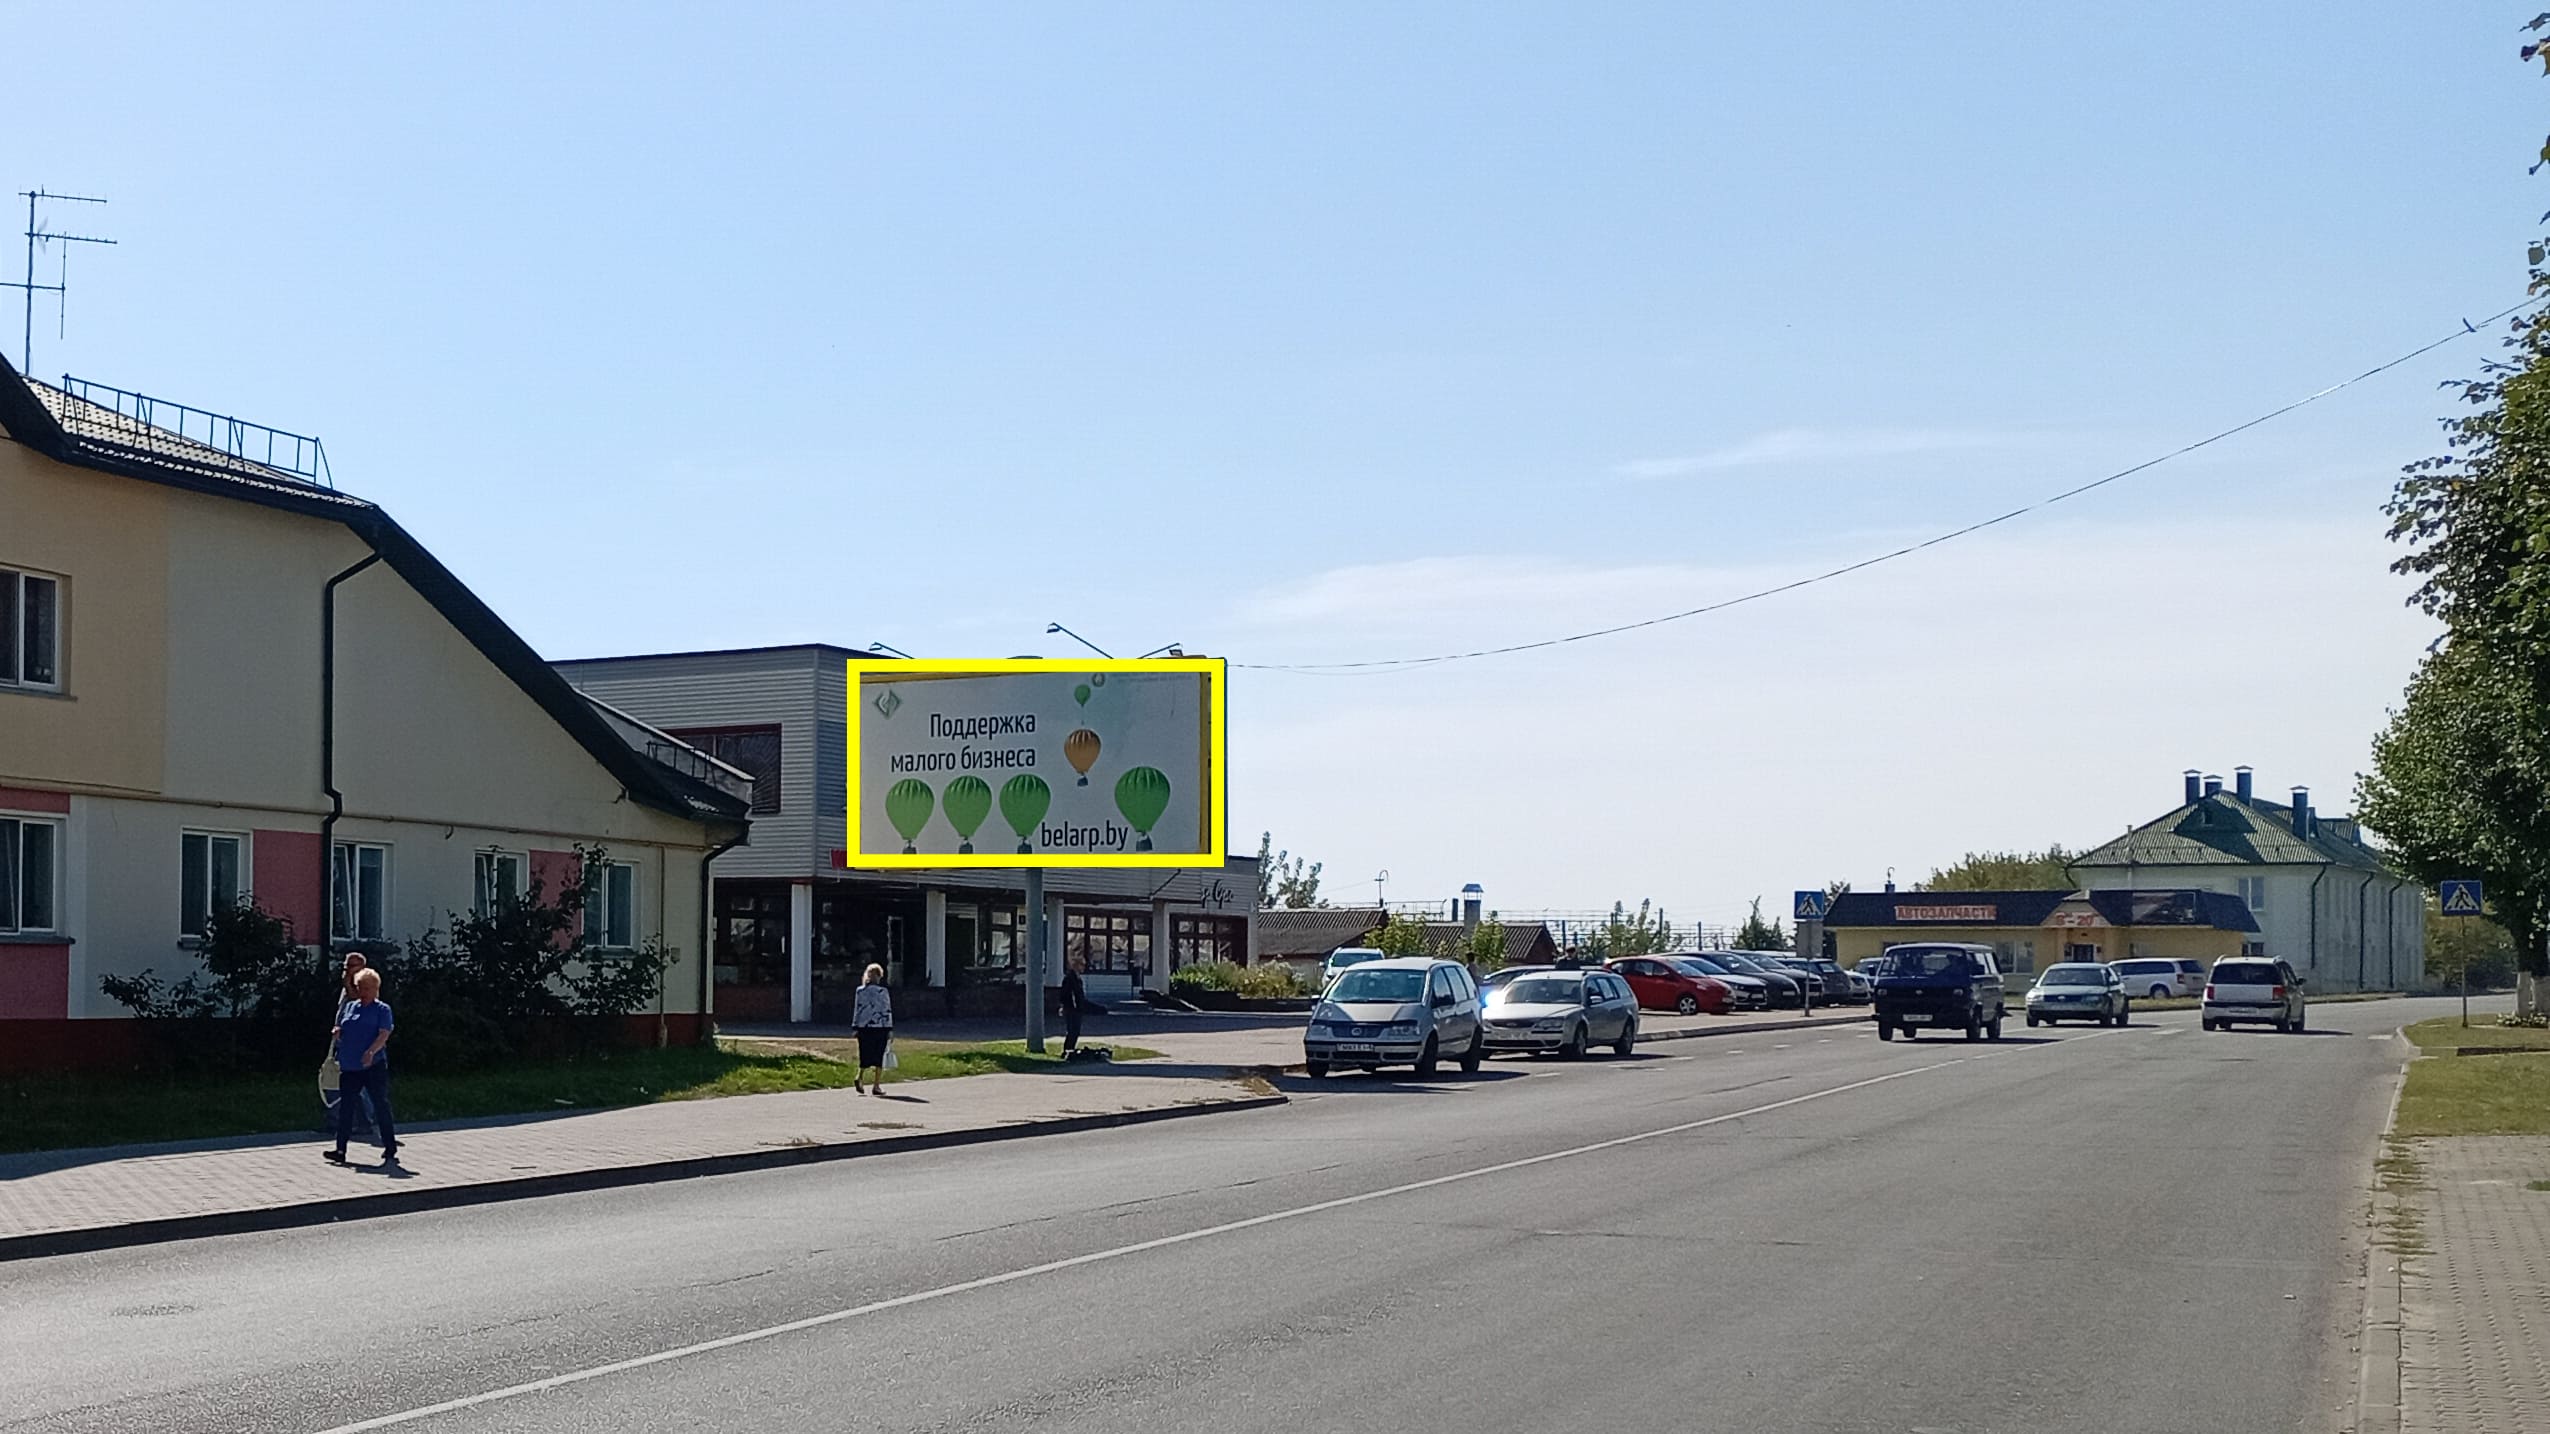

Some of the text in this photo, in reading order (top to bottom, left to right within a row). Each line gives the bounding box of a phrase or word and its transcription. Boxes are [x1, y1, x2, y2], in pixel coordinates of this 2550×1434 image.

[930, 713, 1036, 740] Поддержка
[891, 745, 1036, 772] малого бизнеса
[1041, 820, 1129, 852] belarp.by
